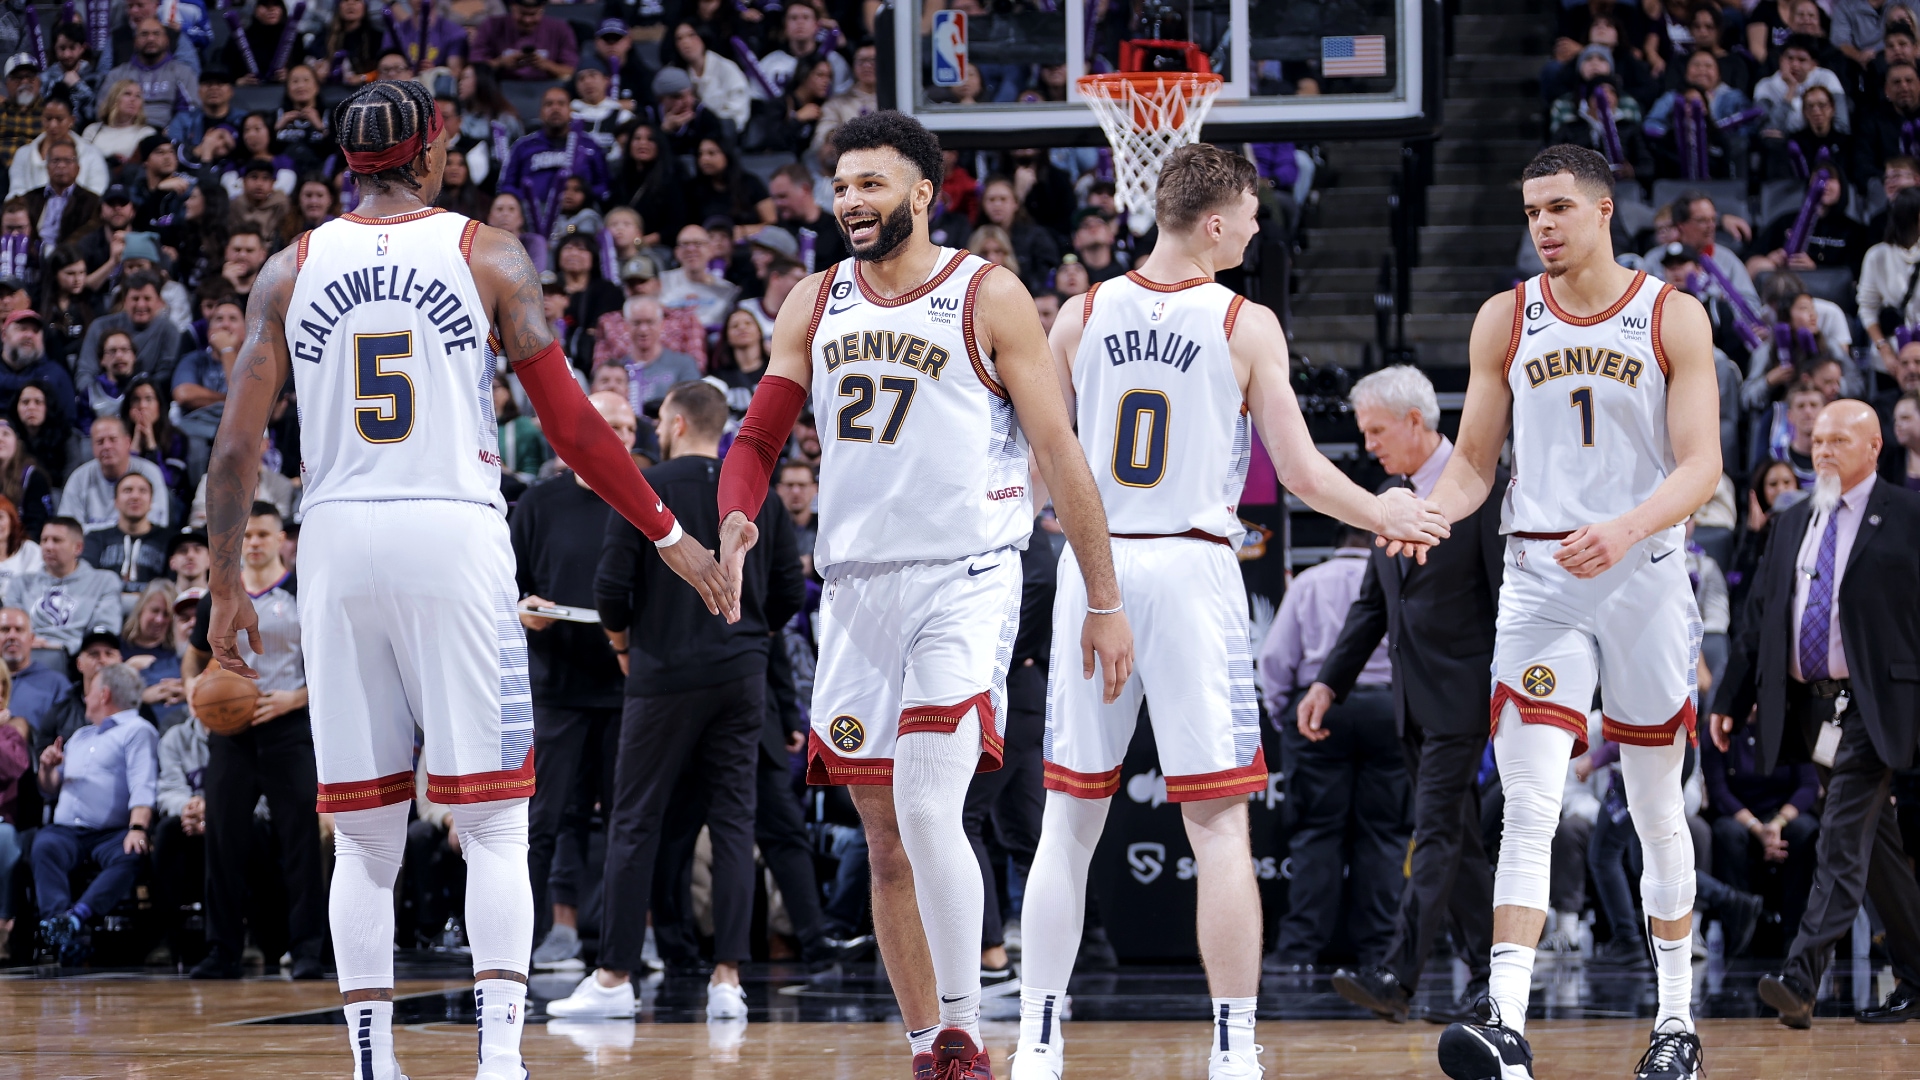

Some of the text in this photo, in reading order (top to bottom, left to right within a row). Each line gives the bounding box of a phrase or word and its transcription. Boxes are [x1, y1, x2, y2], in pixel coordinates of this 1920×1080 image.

[835, 283, 850, 298] 6
[930, 296, 959, 311] WU
[294, 265, 477, 364] CALDWELL-POPE
[927, 310, 957, 319] Western
[930, 316, 951, 324] Union
[1530, 304, 1541, 318] 6
[1622, 315, 1647, 330] WU
[1620, 328, 1647, 336] Western
[821, 330, 950, 381] DENVER
[1104, 329, 1201, 373] BRAUN
[1523, 346, 1644, 388] DENVER
[353, 329, 415, 444] 5
[836, 373, 918, 444] 27
[1569, 386, 1595, 447] 1
[1111, 388, 1171, 488] 0
[986, 486, 1024, 501] NUGGETS
